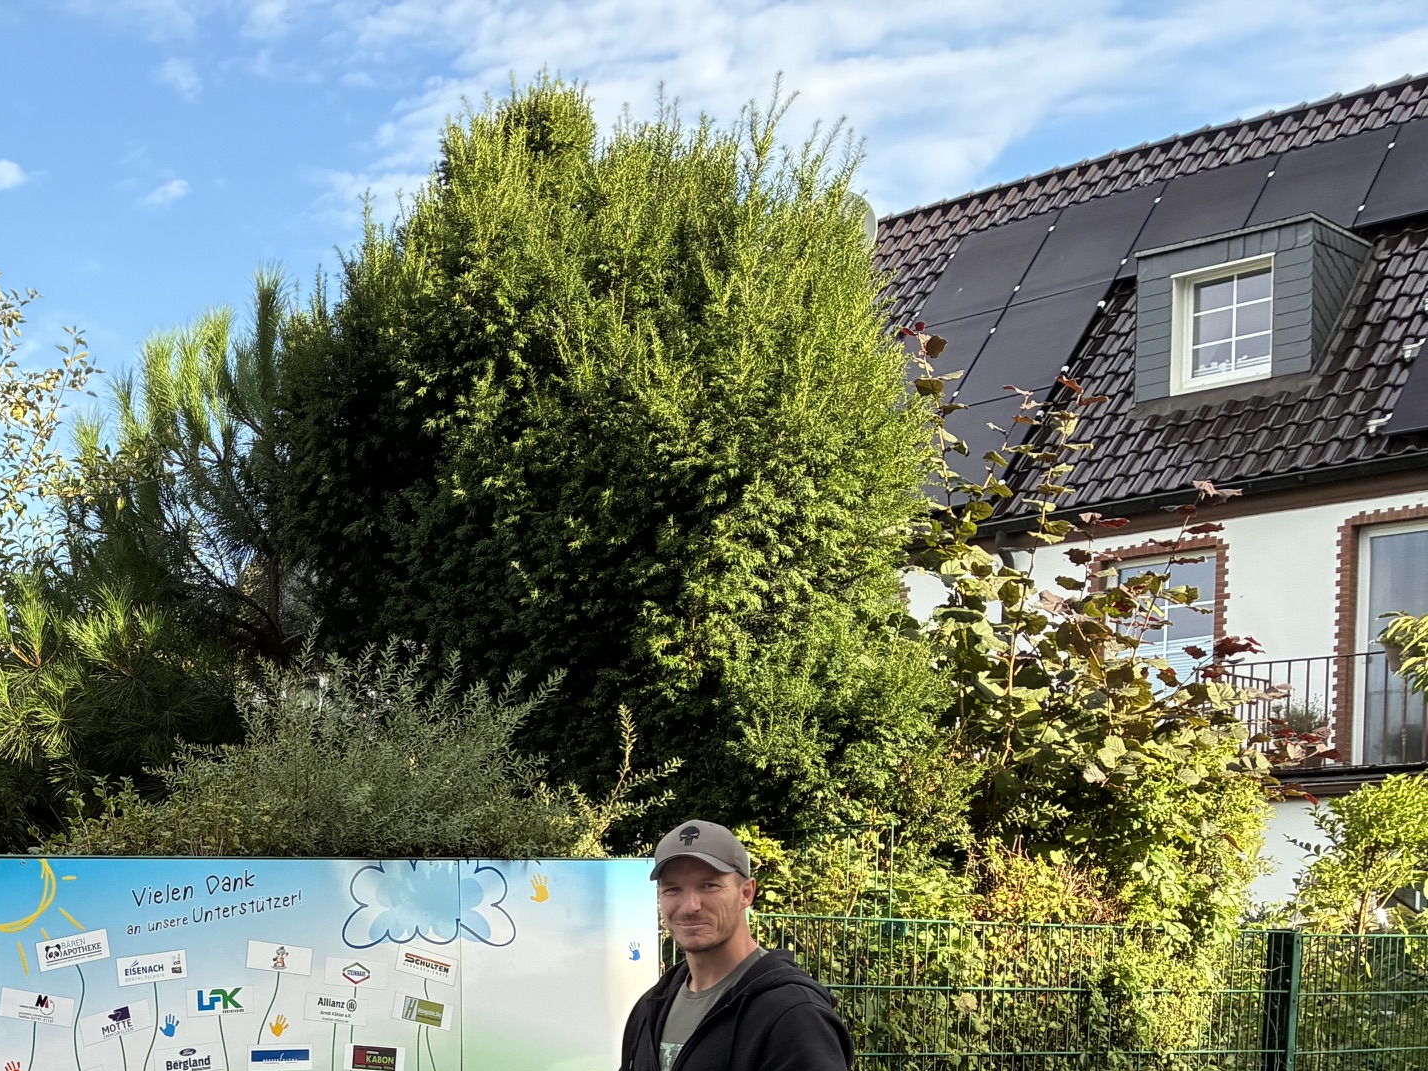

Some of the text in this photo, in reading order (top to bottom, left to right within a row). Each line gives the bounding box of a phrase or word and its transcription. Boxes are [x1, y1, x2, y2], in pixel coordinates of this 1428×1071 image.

[131, 869, 256, 907] Vielen Dank
[126, 889, 303, 935] an unsere Unterstützer!
[60, 937, 86, 949] BÄREN
[62, 942, 102, 958] APOTHEKE
[124, 963, 164, 976] EISENACH
[404, 952, 451, 974] SCHULTEN
[317, 997, 345, 1009] Allianz
[101, 1020, 133, 1036] MOTTE
[103, 1028, 134, 1040] IMMOBILIEN
[166, 1055, 211, 1071] Bergland
[366, 1055, 395, 1065] KABON
